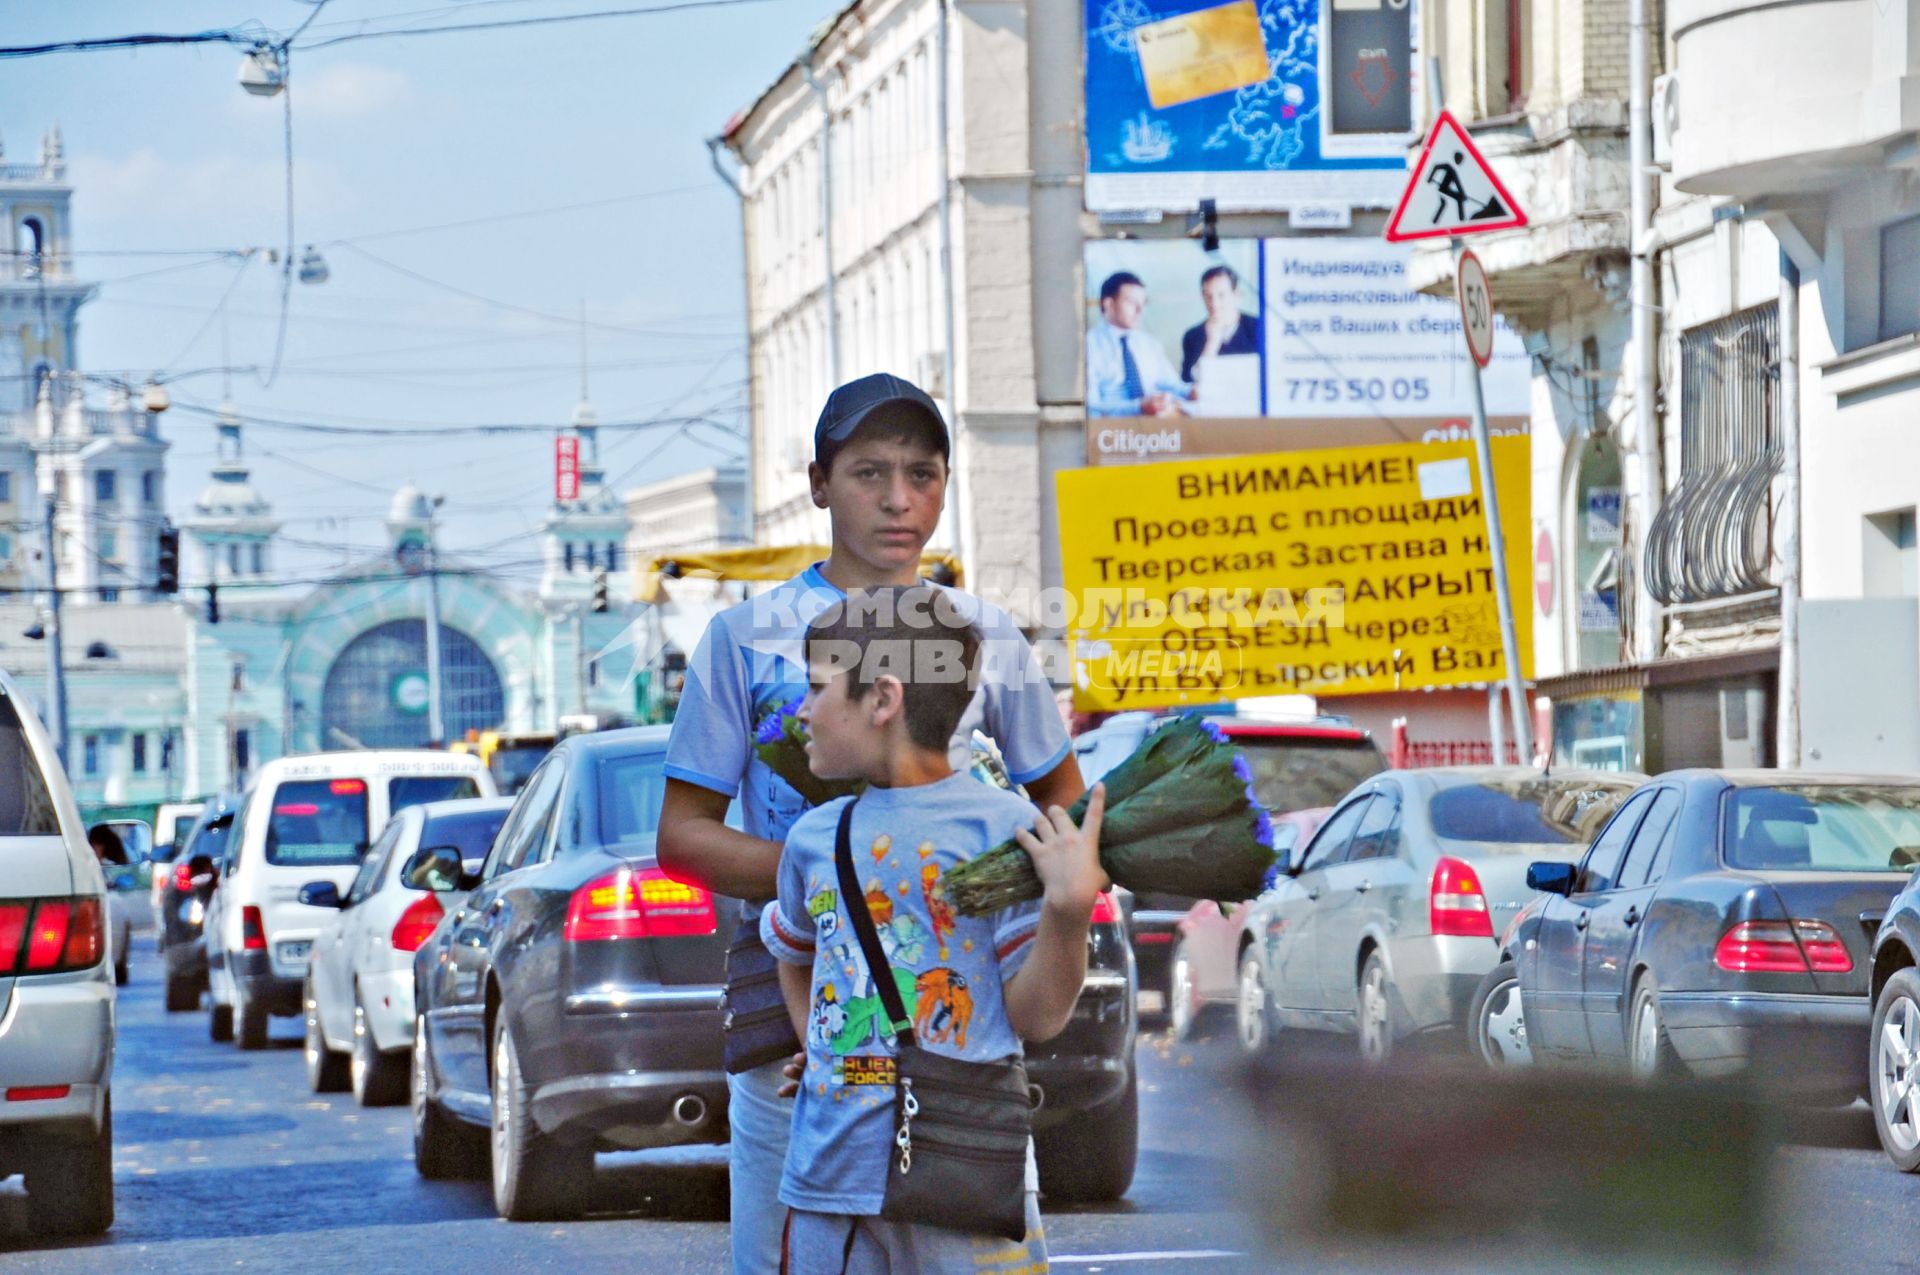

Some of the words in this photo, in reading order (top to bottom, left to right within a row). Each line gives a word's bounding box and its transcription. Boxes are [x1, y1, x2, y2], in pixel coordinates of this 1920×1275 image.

[1284, 318, 1322, 336] для
[1330, 315, 1401, 334] Ваших
[1465, 285, 1487, 330] 50
[1287, 378, 1340, 401] 775
[1346, 378, 1386, 401] 50
[1392, 378, 1430, 401] 05
[1097, 429, 1182, 457] Citigold
[1178, 457, 1415, 500] ВНИМАНИЕ!
[1113, 512, 1257, 549] Проезд
[1269, 511, 1291, 532] с
[1304, 497, 1481, 529] площади
[1093, 550, 1276, 583] Тверская
[1288, 537, 1447, 568] Застава
[1326, 567, 1494, 606] ЗАКРЫТ
[1161, 619, 1331, 653] ОБЪЕЗД
[1344, 615, 1450, 643] через
[845, 1057, 896, 1071] ALIEN
[845, 1072, 896, 1086] FORCE
